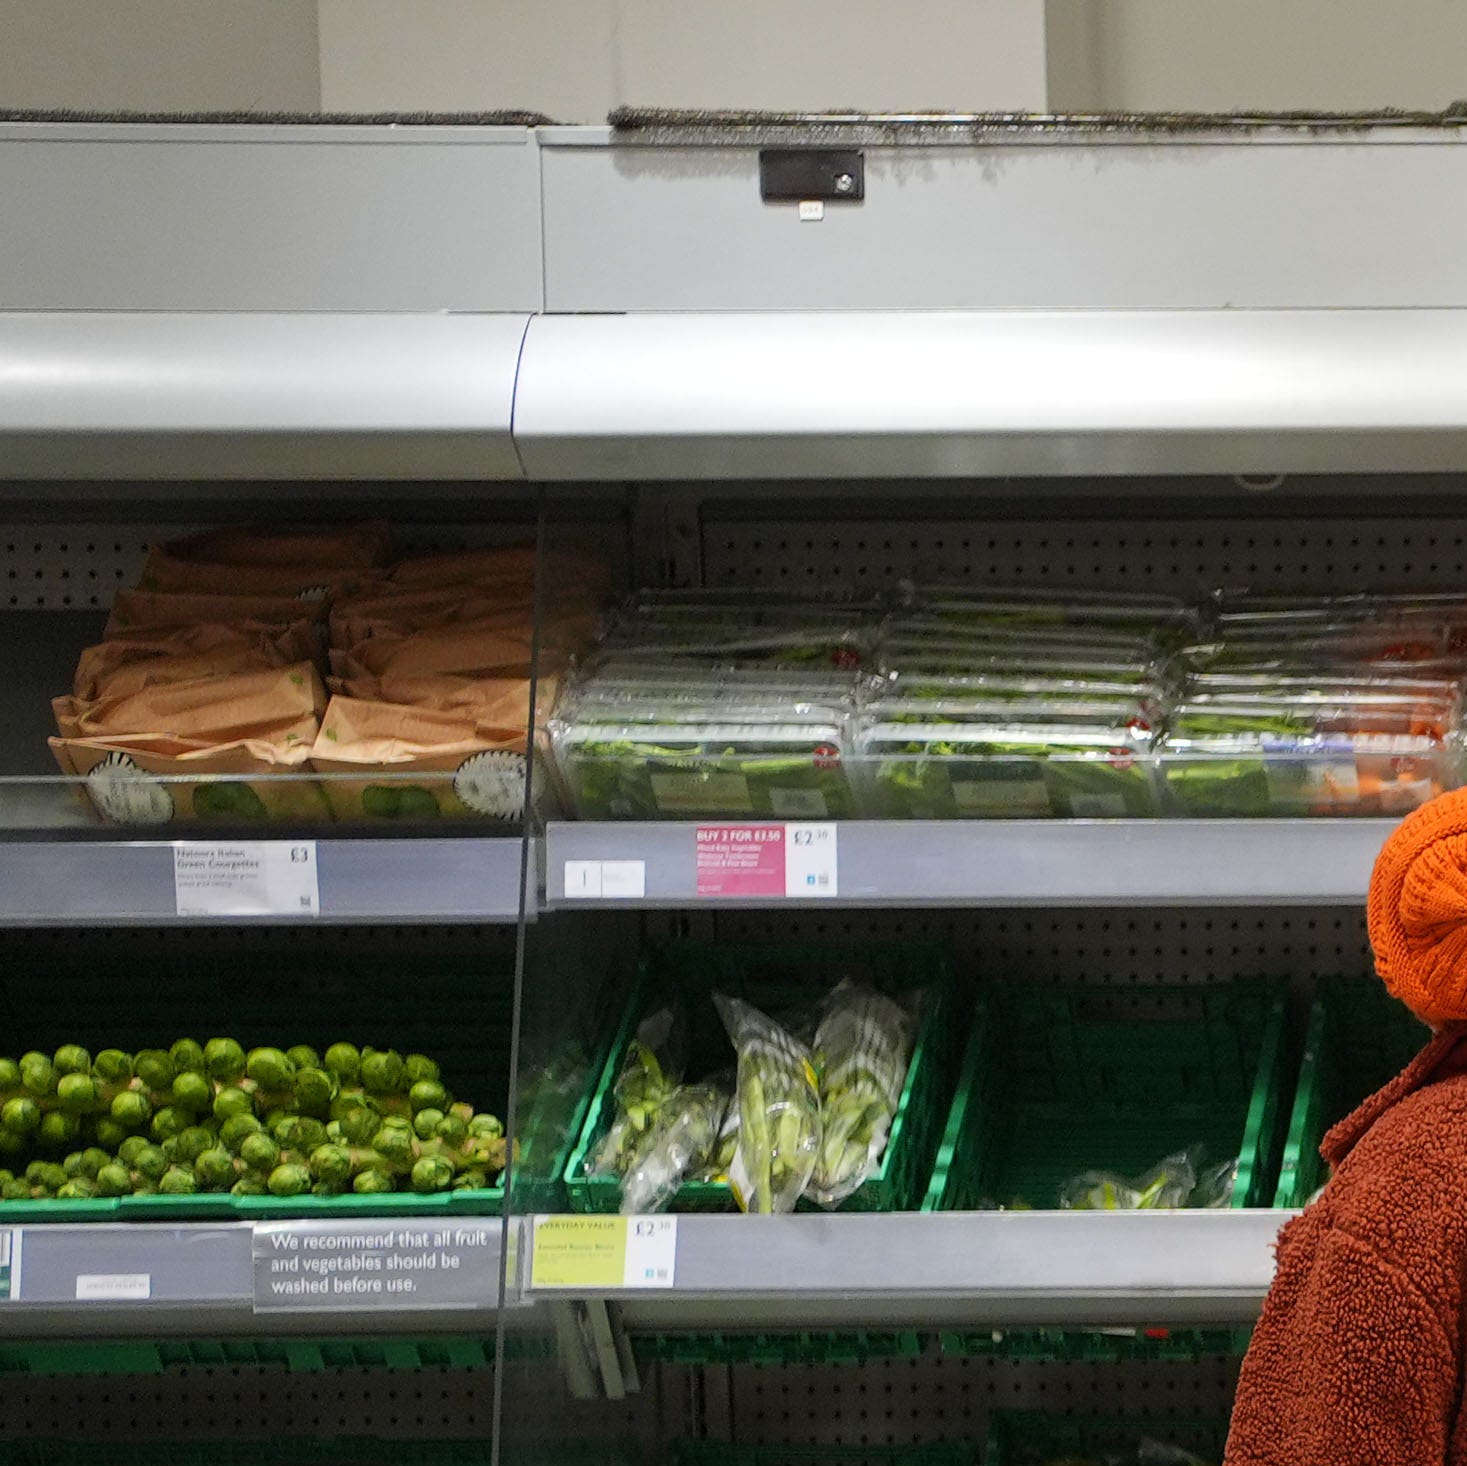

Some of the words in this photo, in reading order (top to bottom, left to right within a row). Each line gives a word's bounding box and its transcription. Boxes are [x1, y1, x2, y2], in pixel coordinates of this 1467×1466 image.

[696, 830, 719, 842] BUY
[730, 830, 753, 842] FOR
[271, 1232, 299, 1250] We
[303, 1231, 394, 1250] recommend
[398, 1231, 429, 1248] that
[434, 1230, 450, 1247] all
[455, 1228, 488, 1246] fruit
[271, 1254, 299, 1272] and
[303, 1253, 381, 1275] vegetables
[386, 1251, 436, 1270] should
[441, 1251, 460, 1268] be
[271, 1277, 329, 1295] washed
[333, 1276, 382, 1294] before
[387, 1278, 417, 1293] use.
